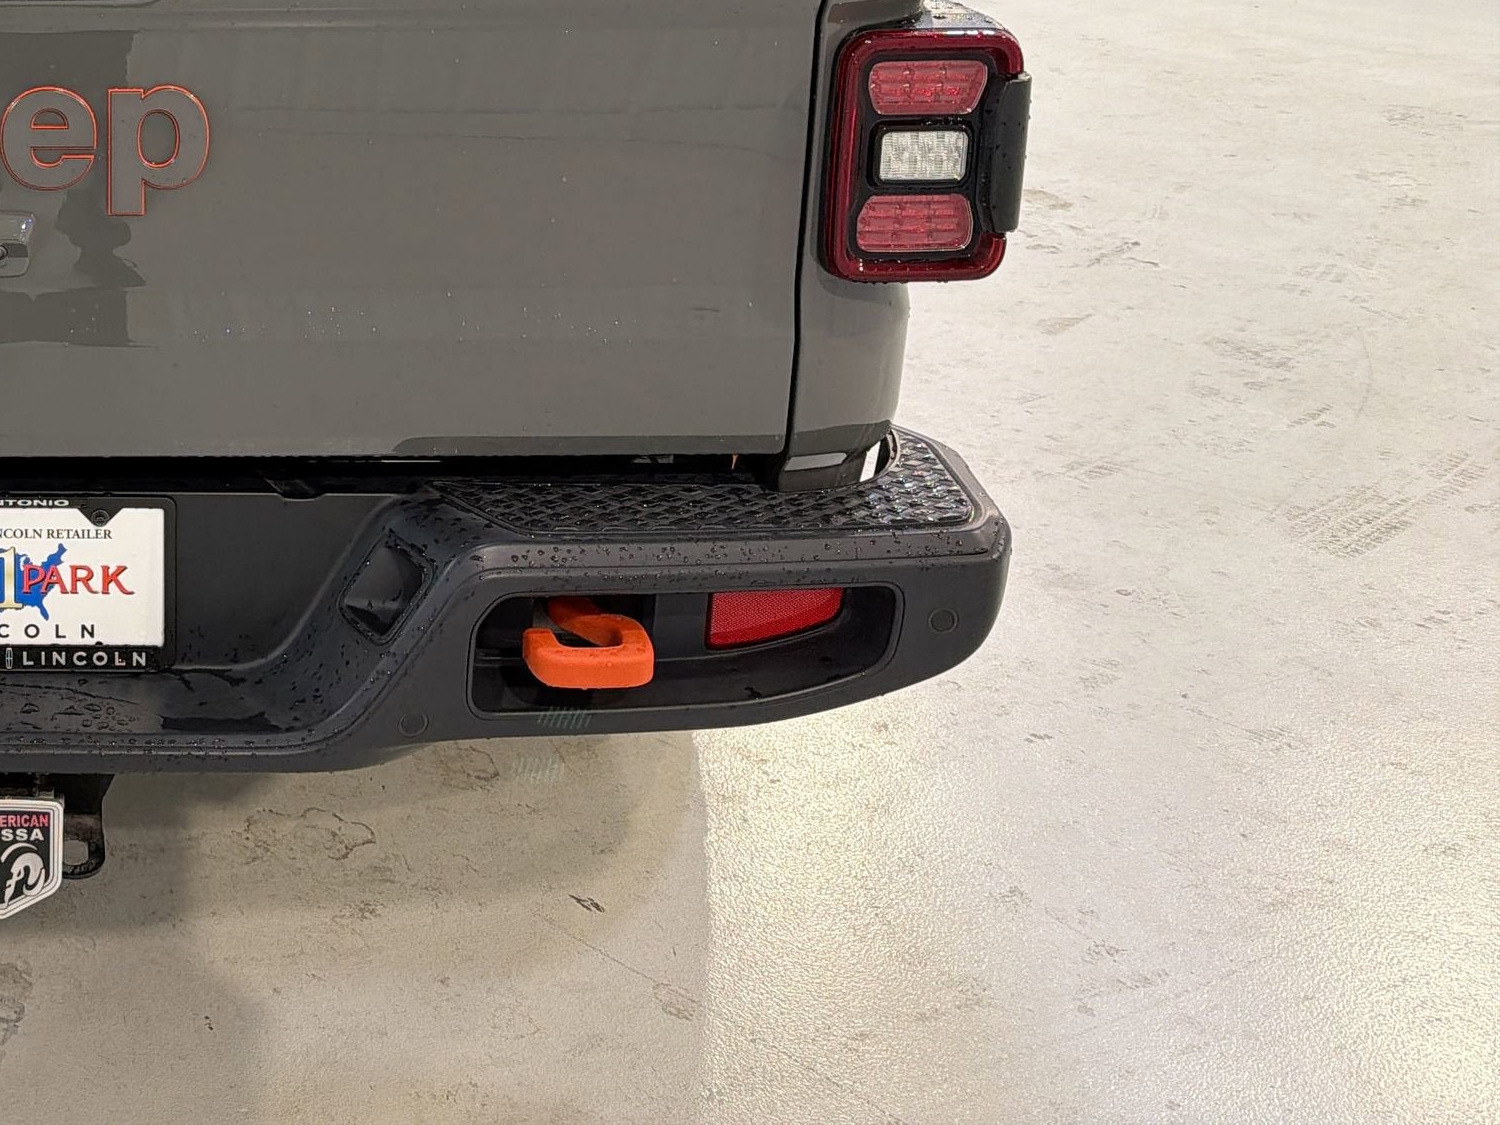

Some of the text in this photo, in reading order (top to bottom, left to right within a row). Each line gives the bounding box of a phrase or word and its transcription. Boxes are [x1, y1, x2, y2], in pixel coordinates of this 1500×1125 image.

[46, 528, 113, 540] RETAILER
[22, 564, 136, 595] PARK
[21, 650, 148, 668] LINCOLN
